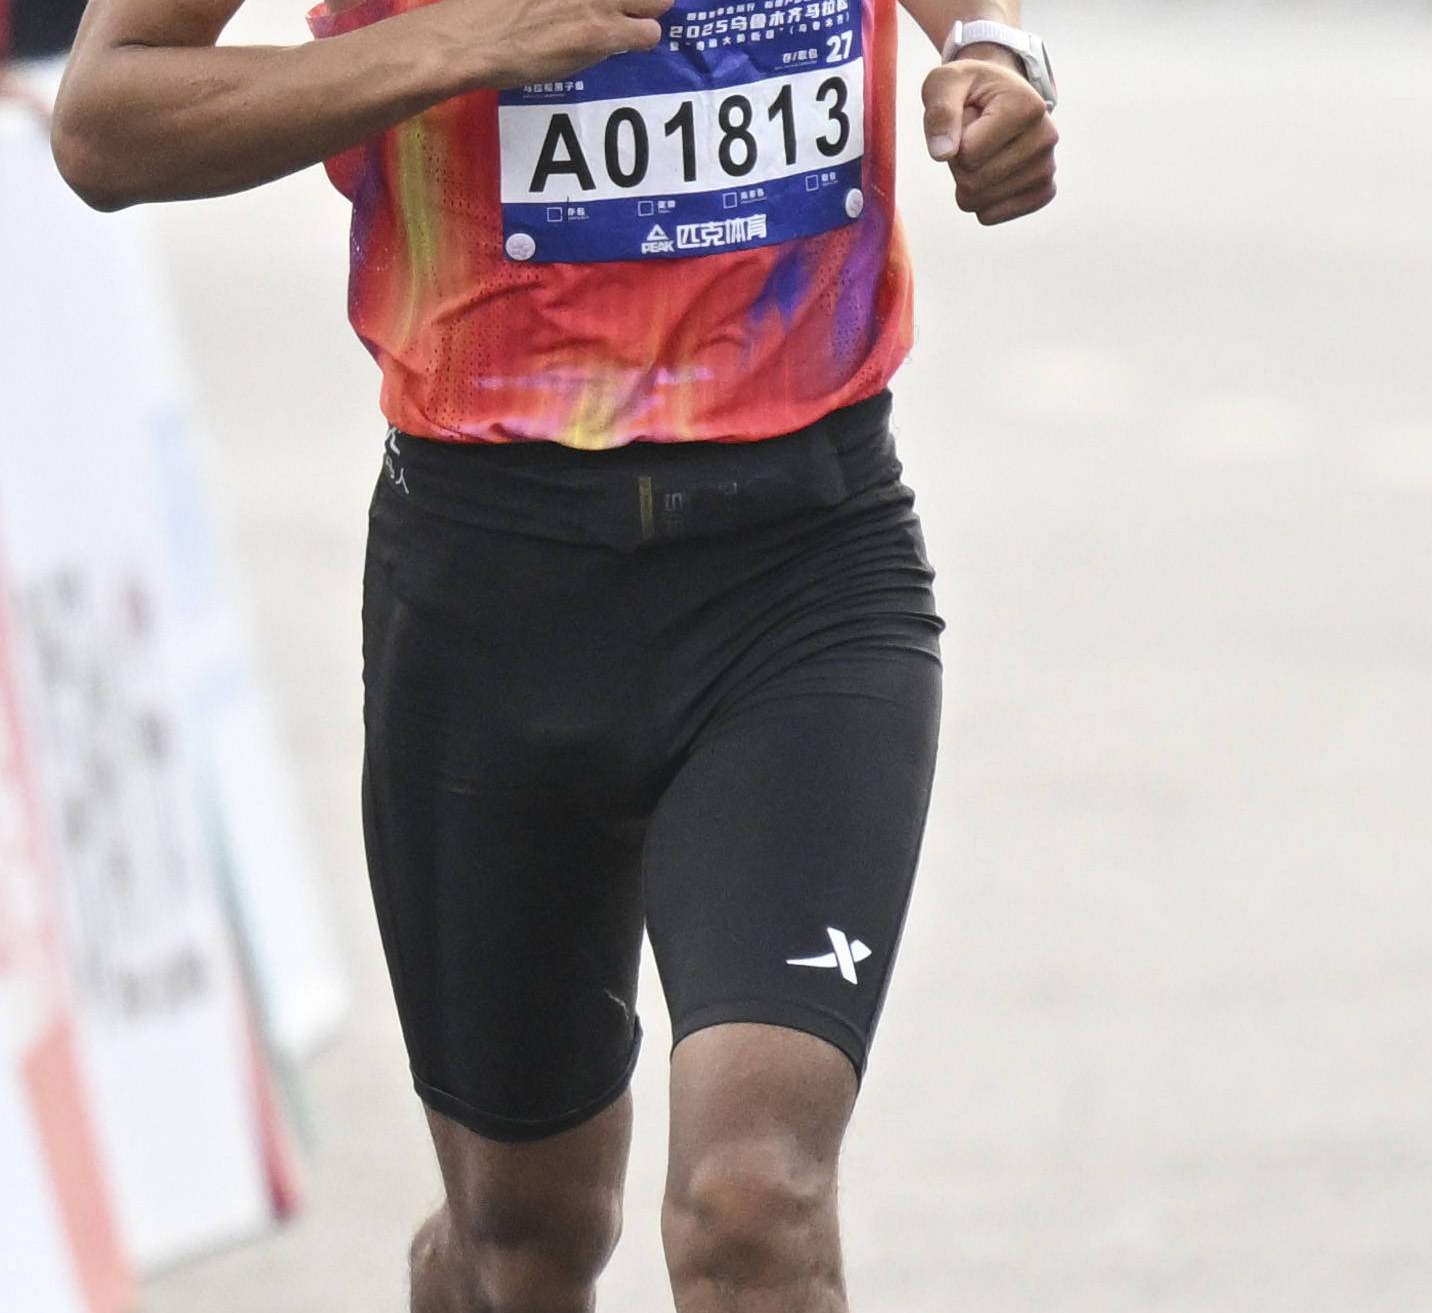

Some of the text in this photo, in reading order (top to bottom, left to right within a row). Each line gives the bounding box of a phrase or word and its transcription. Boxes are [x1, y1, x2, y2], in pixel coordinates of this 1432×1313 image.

[826, 30, 853, 63] 27
[529, 75, 850, 193] A01813
[641, 214, 767, 255] PEAK 匹克体育
